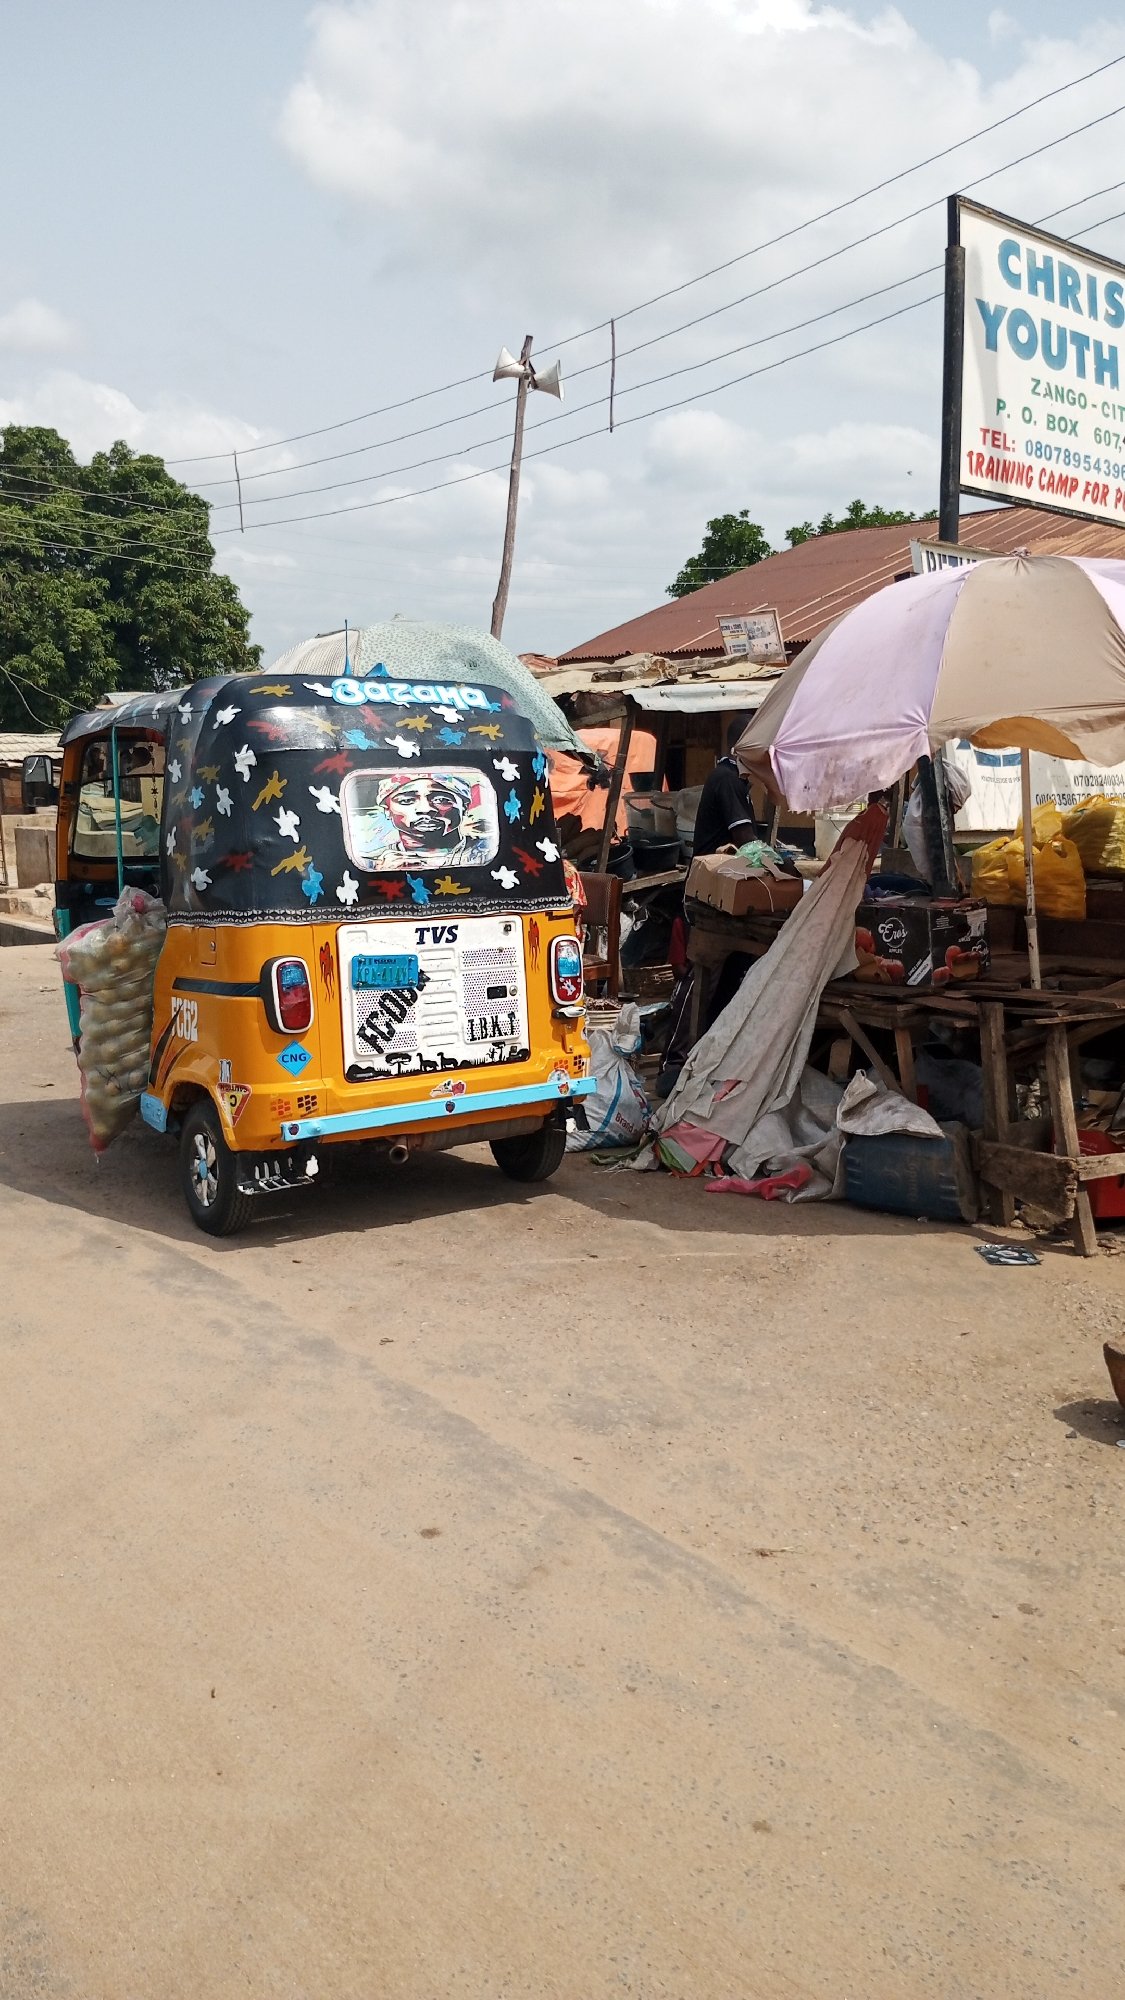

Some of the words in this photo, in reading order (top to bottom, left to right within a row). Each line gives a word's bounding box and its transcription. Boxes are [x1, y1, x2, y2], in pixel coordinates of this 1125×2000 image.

[998, 238, 1125, 329] CHRIS
[976, 298, 1120, 391] YOUTH
[1046, 413, 1079, 437] BOX
[980, 428, 1016, 453] TEL:
[967, 450, 1034, 489] TRAINING
[1038, 467, 1079, 498] CAMP
[1082, 480, 1110, 507] FOR
[414, 924, 459, 945] TVS
[878, 923, 908, 943] Eros
[281, 1053, 307, 1063] CNG
